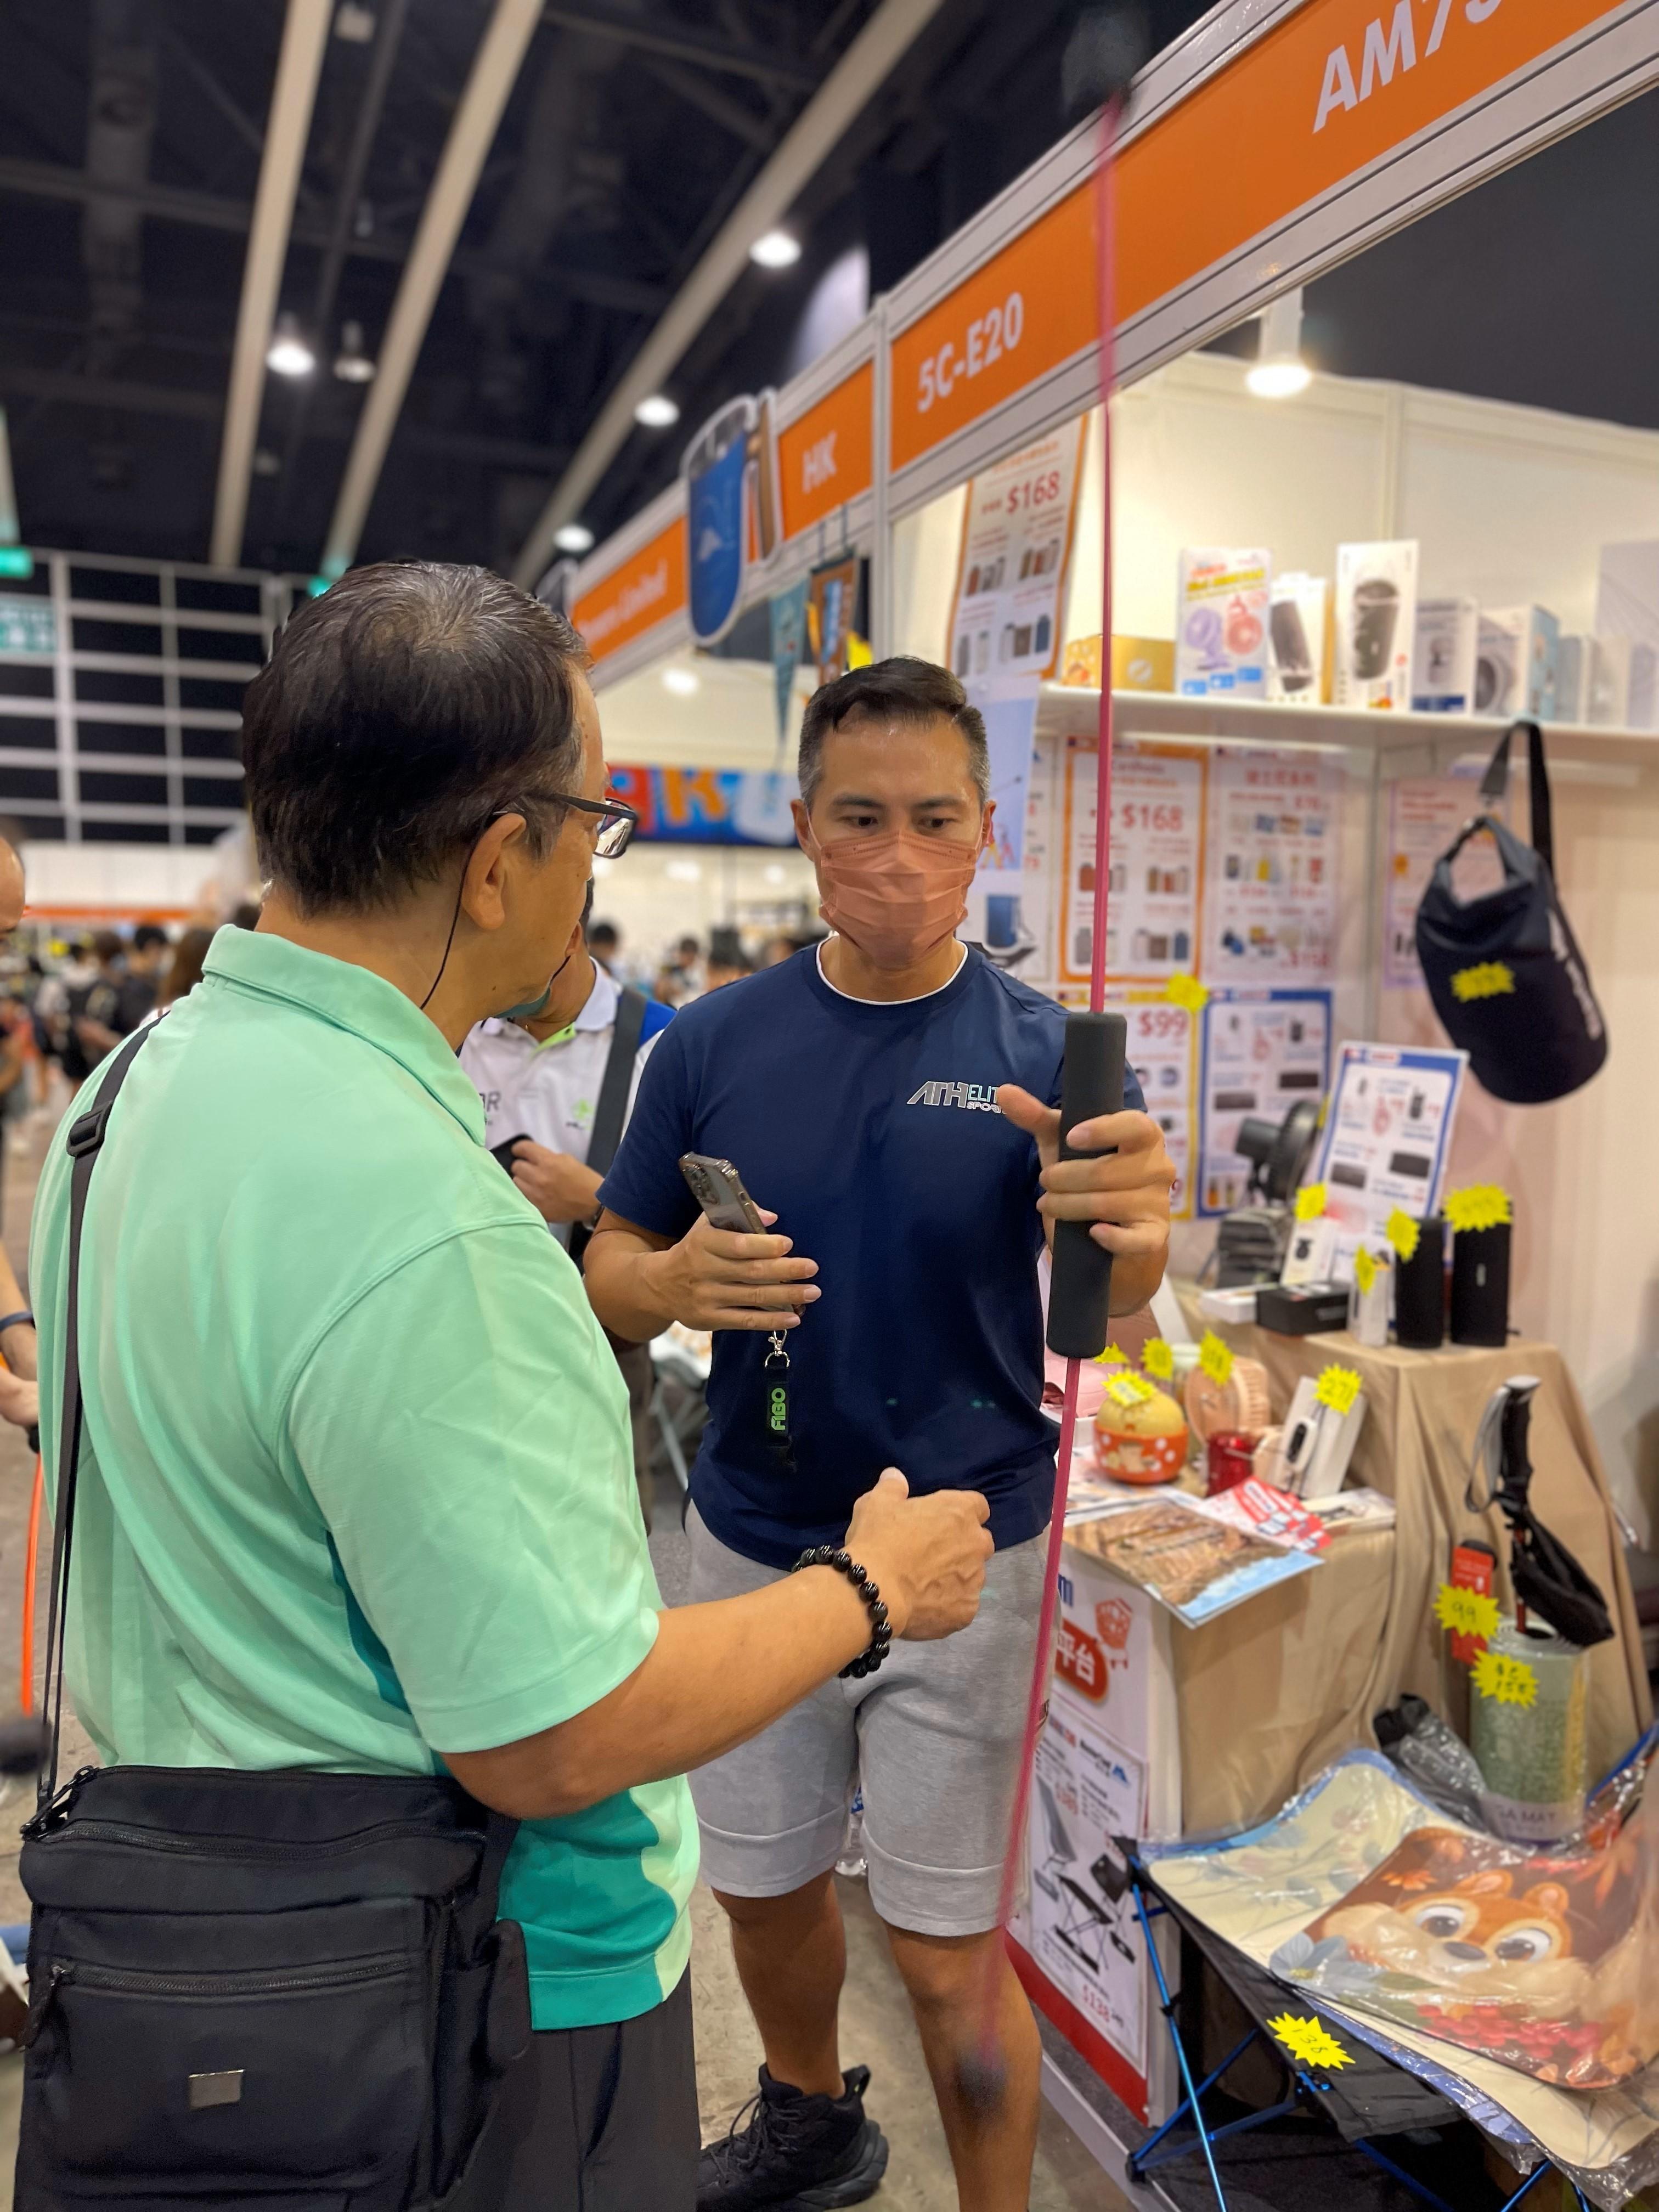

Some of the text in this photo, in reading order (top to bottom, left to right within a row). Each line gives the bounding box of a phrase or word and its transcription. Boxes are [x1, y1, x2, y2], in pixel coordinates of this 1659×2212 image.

[917, 291, 1024, 414] 5C-E20
[802, 430, 838, 494] HK
[1006, 471, 1060, 514] $168
[1122, 803, 1183, 832] $168
[1138, 1009, 1188, 1039] $99
[907, 1081, 1000, 1108] ATHELIT
[771, 1387, 786, 1431] FIBO
[1452, 1601, 1476, 1622] 99
[1291, 2028, 1329, 2053] 138
